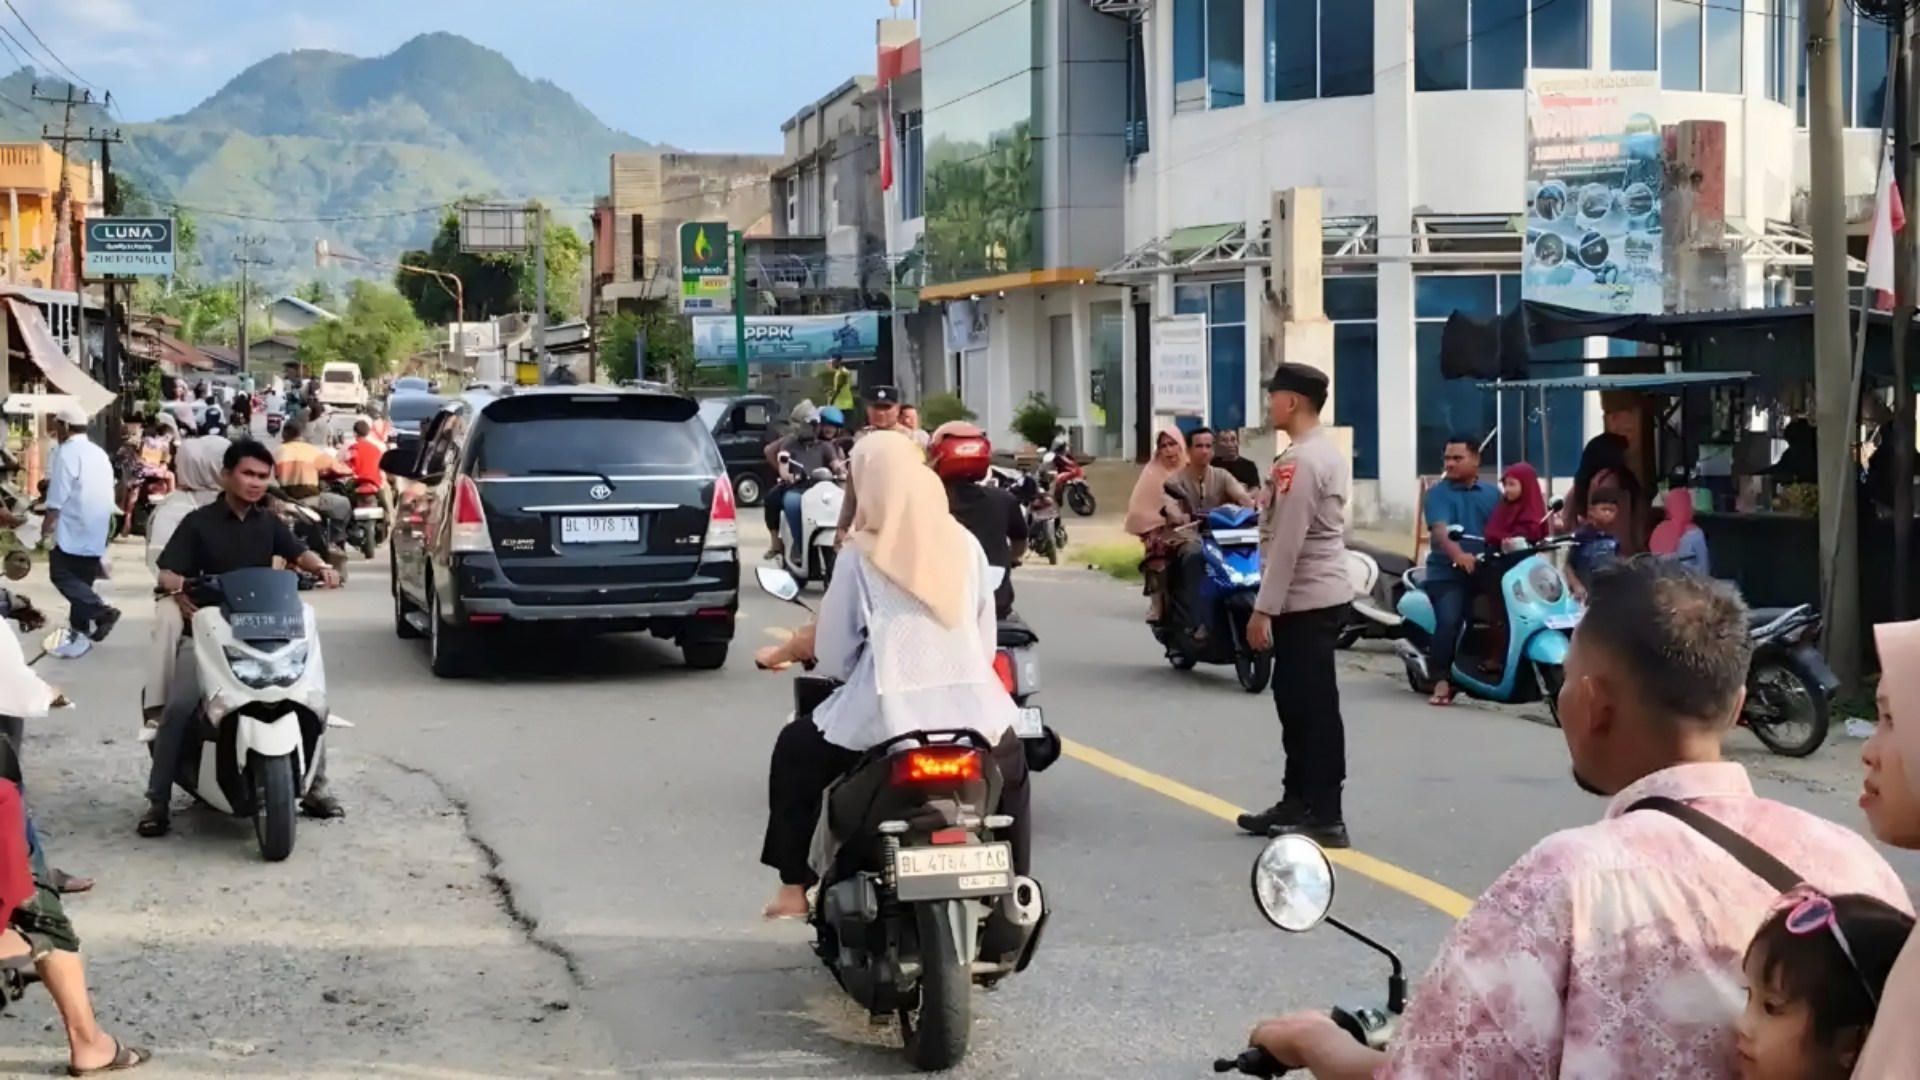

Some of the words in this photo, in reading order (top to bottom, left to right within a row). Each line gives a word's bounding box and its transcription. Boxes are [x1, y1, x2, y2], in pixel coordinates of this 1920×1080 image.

[105, 226, 153, 238] LUNA
[744, 325, 793, 341] PPPK
[902, 855, 922, 873] BL
